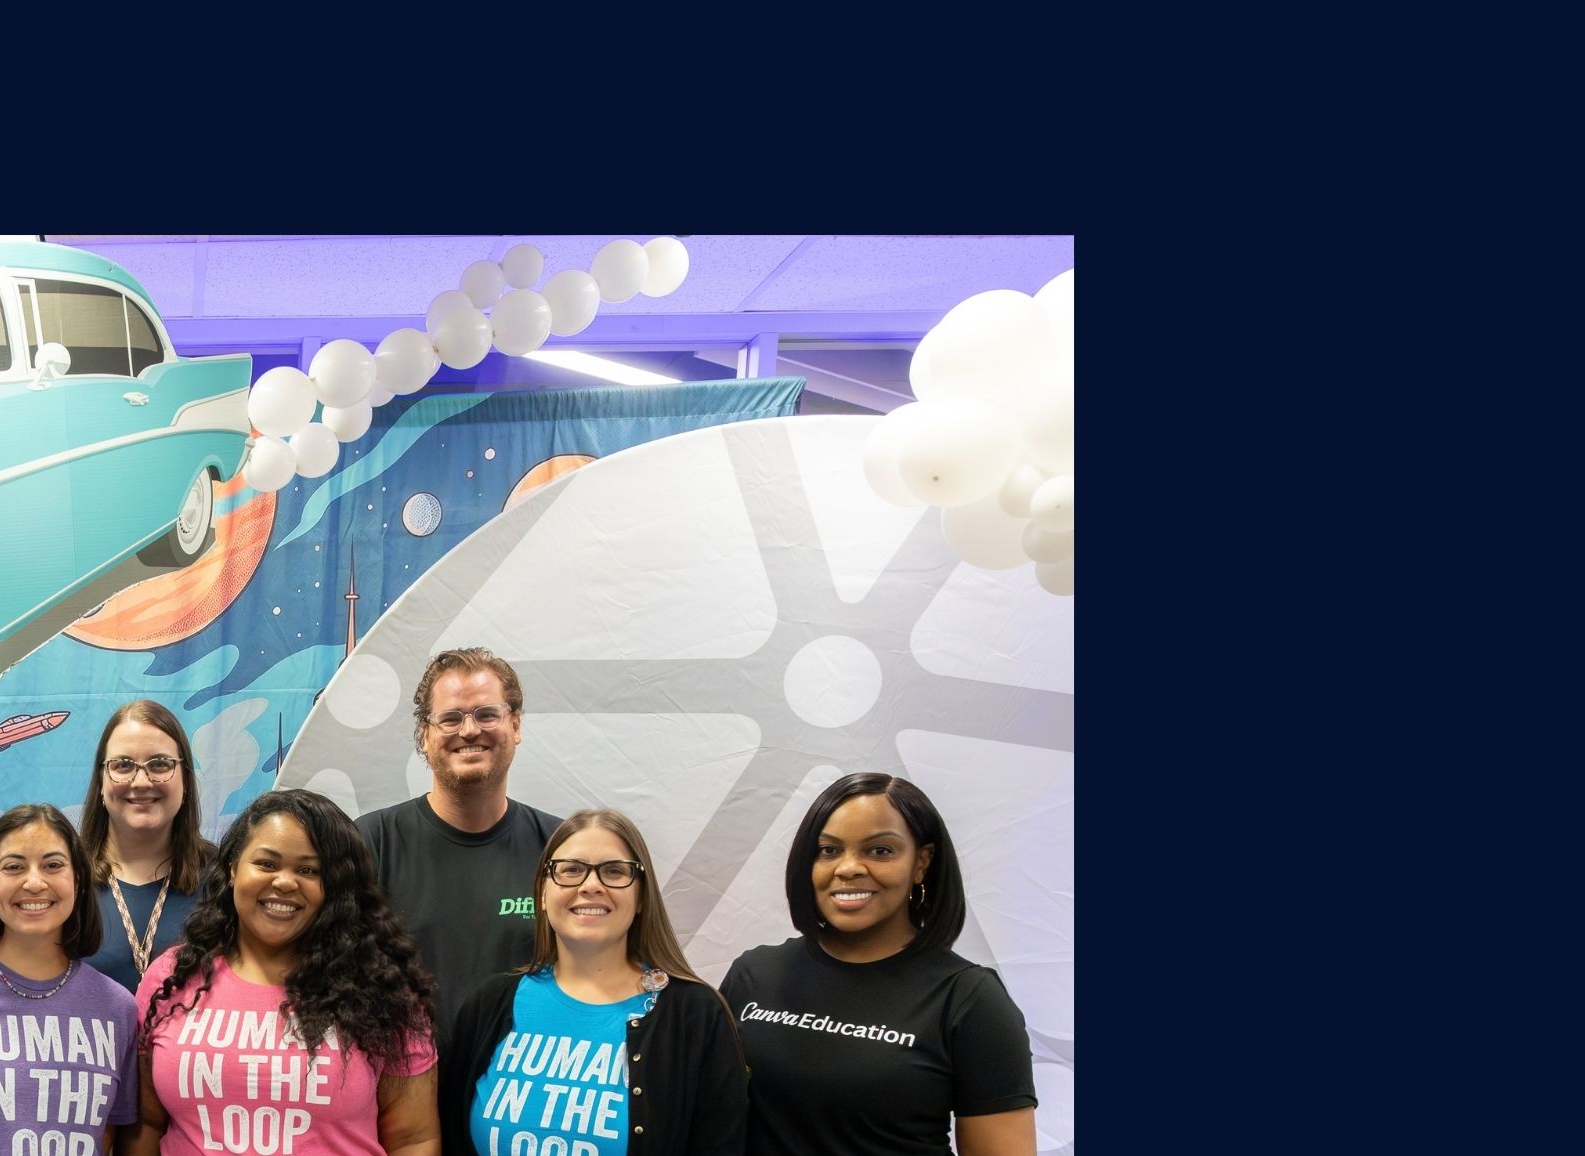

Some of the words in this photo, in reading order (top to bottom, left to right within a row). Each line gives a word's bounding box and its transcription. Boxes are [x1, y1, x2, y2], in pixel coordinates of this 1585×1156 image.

[740, 1002, 917, 1047] CanvaEducation
[29, 1068, 112, 1127] THE
[178, 1051, 224, 1098] IN
[238, 1055, 332, 1105] THE
[197, 1104, 312, 1156] LOOP
[482, 1077, 534, 1124] IN
[540, 1083, 624, 1140] THE
